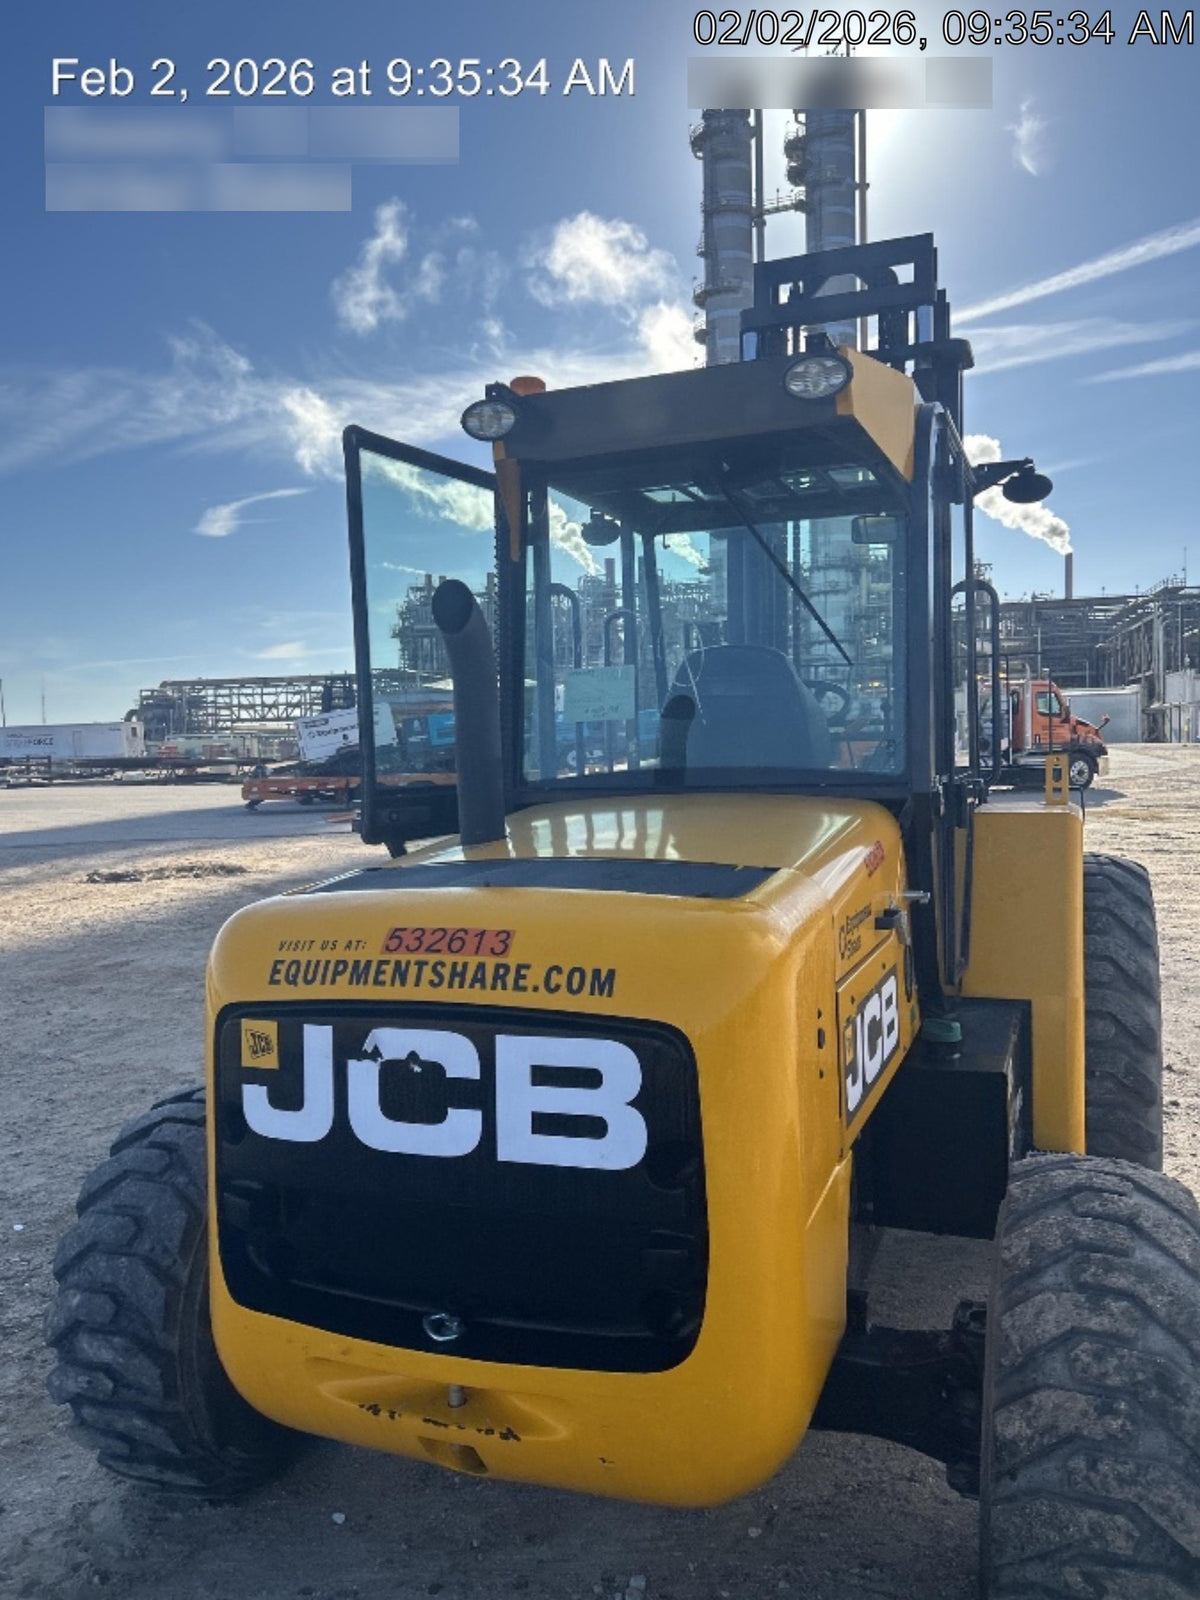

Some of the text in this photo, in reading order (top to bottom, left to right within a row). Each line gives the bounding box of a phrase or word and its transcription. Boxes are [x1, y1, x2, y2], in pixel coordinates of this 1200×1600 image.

[278, 939, 368, 952] VISIT US AT:
[384, 927, 513, 957] 532613
[267, 958, 618, 998] EQUIPMENTSHARE.COM
[846, 975, 898, 1112] JCB
[242, 1023, 648, 1171] JCB
